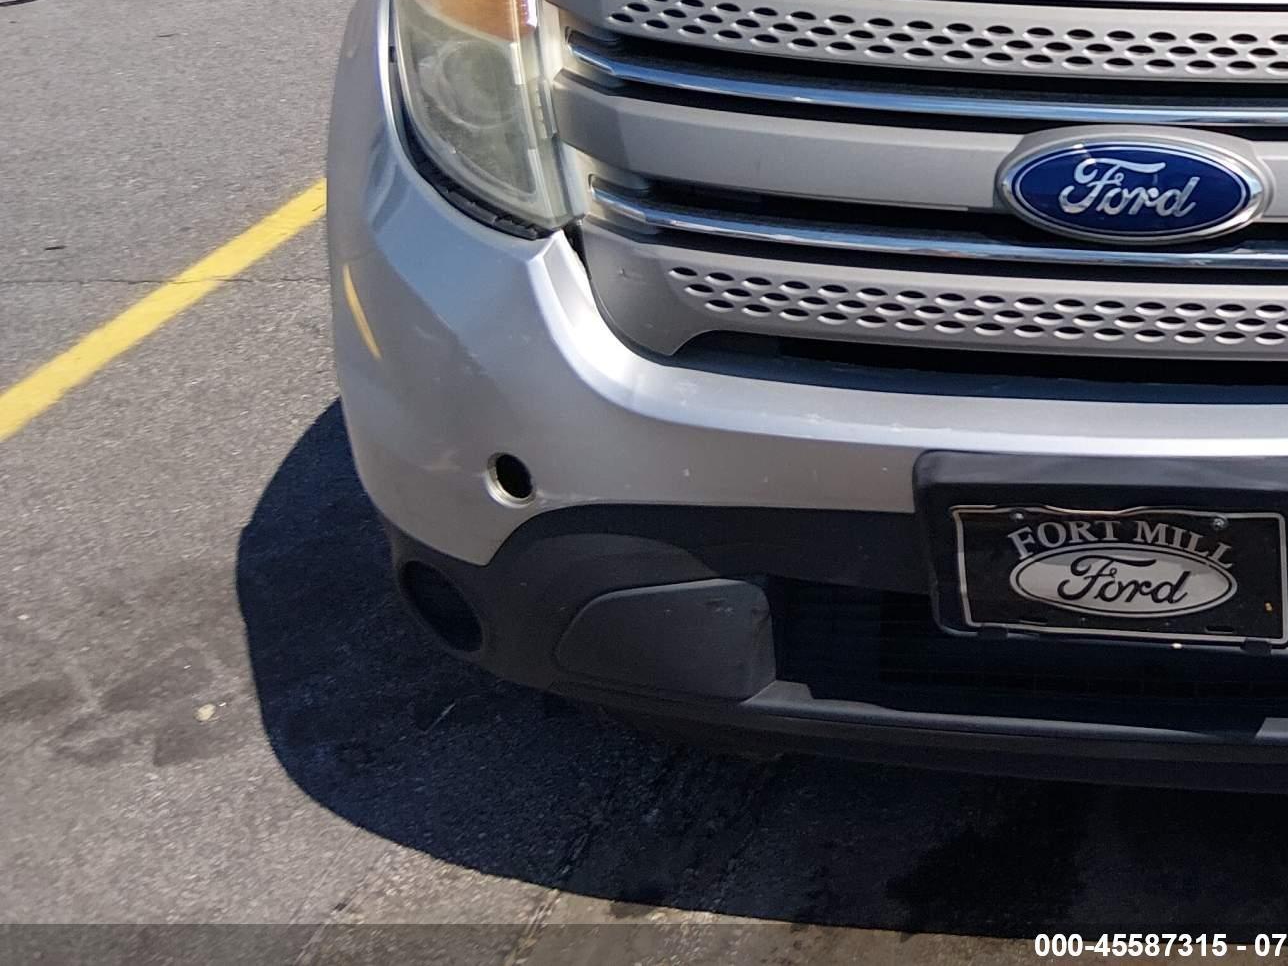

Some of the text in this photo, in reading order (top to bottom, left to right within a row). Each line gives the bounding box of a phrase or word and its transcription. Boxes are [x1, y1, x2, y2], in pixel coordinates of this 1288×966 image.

[1058, 157, 1200, 217] Ford
[1008, 520, 1233, 569] FORT MILL
[1057, 555, 1189, 604] Ford
